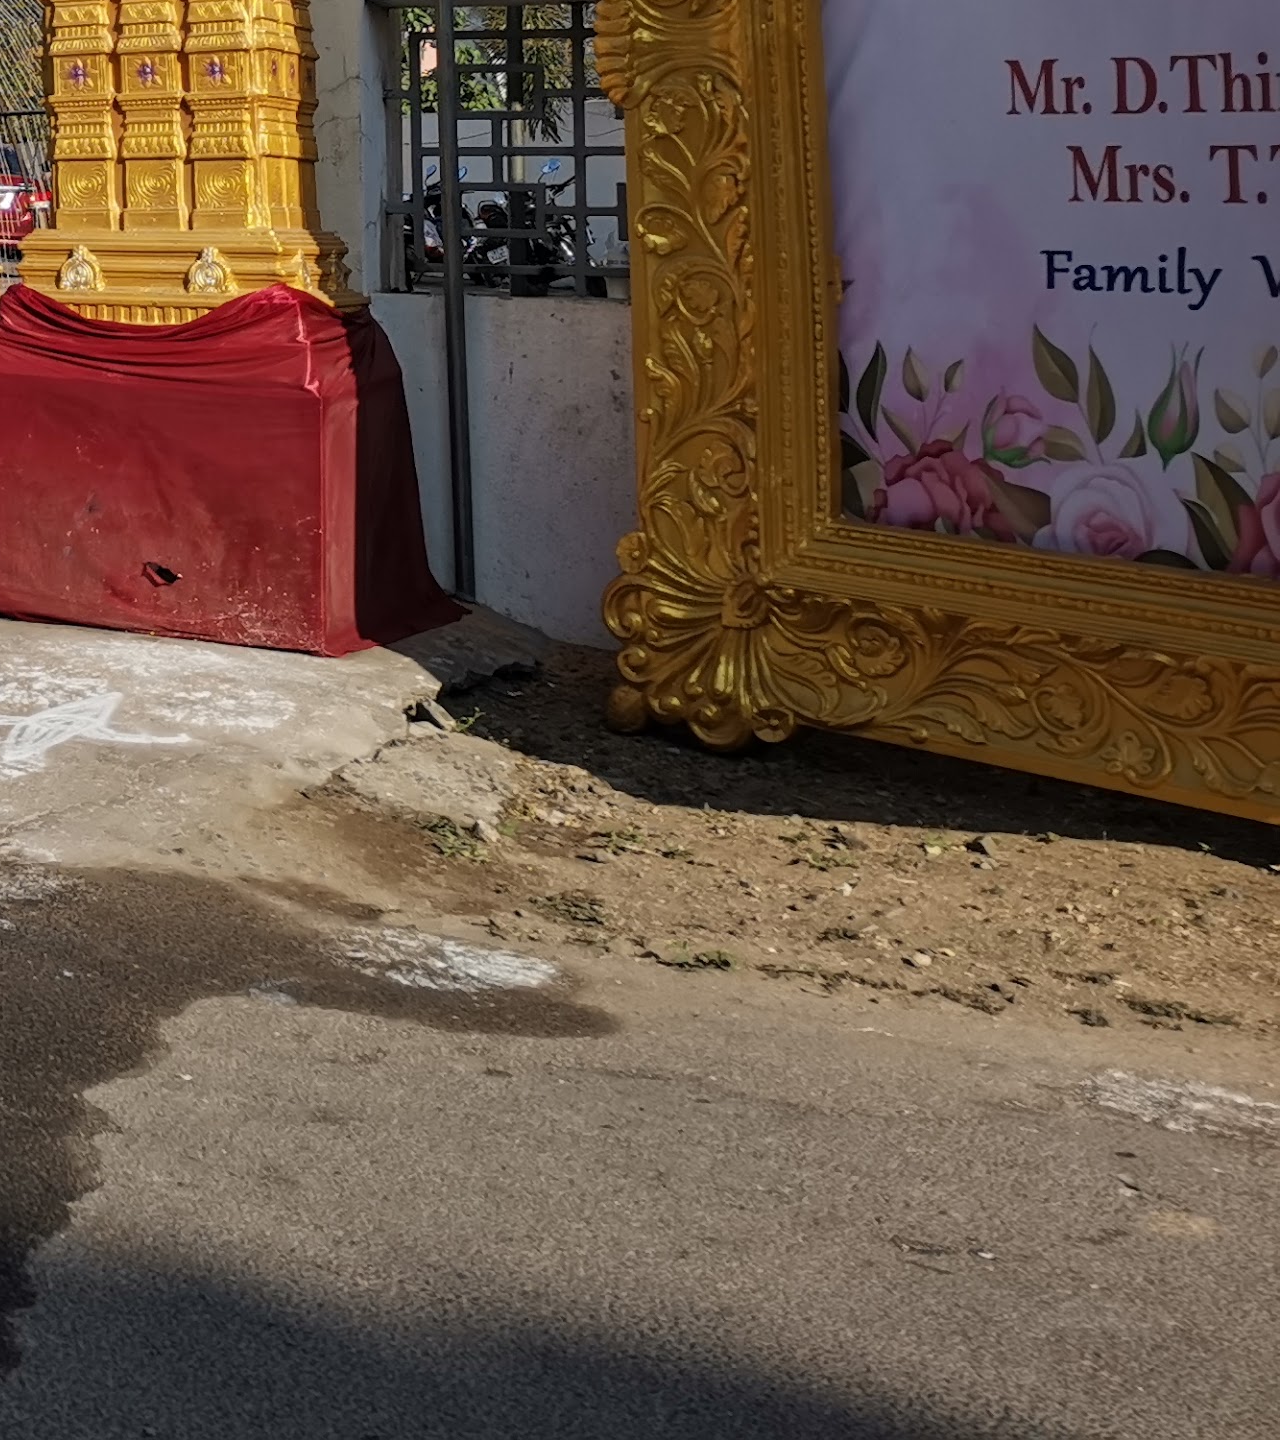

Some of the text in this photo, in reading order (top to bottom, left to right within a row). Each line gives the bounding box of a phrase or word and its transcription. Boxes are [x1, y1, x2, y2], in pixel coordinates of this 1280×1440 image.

[1004, 51, 1280, 115] Mr. D.Thi
[1066, 144, 1280, 205] Mrs. T.
[1039, 246, 1223, 311] Family
